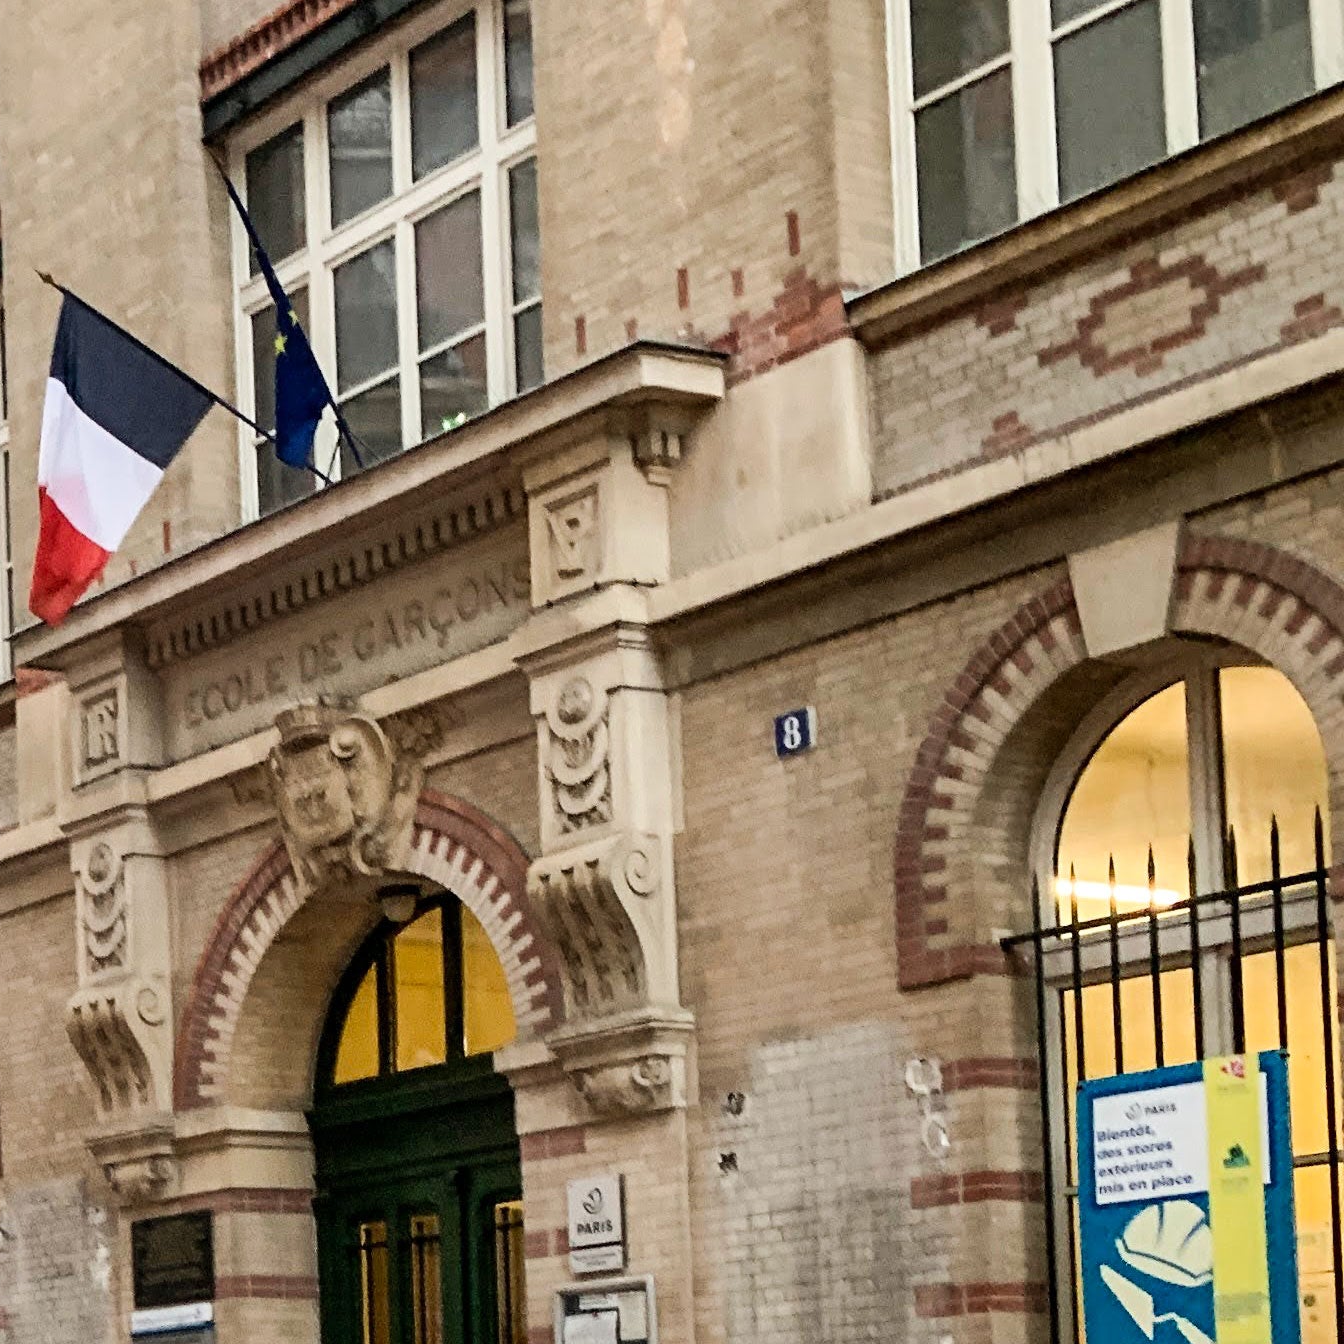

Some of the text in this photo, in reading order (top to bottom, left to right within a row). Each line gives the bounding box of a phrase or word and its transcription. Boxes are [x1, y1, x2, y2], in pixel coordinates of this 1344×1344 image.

[783, 716, 802, 749] 8
[1127, 1141, 1173, 1156] stores
[1099, 1174, 1193, 1195] mis en place
[577, 1219, 613, 1234] PARIS
